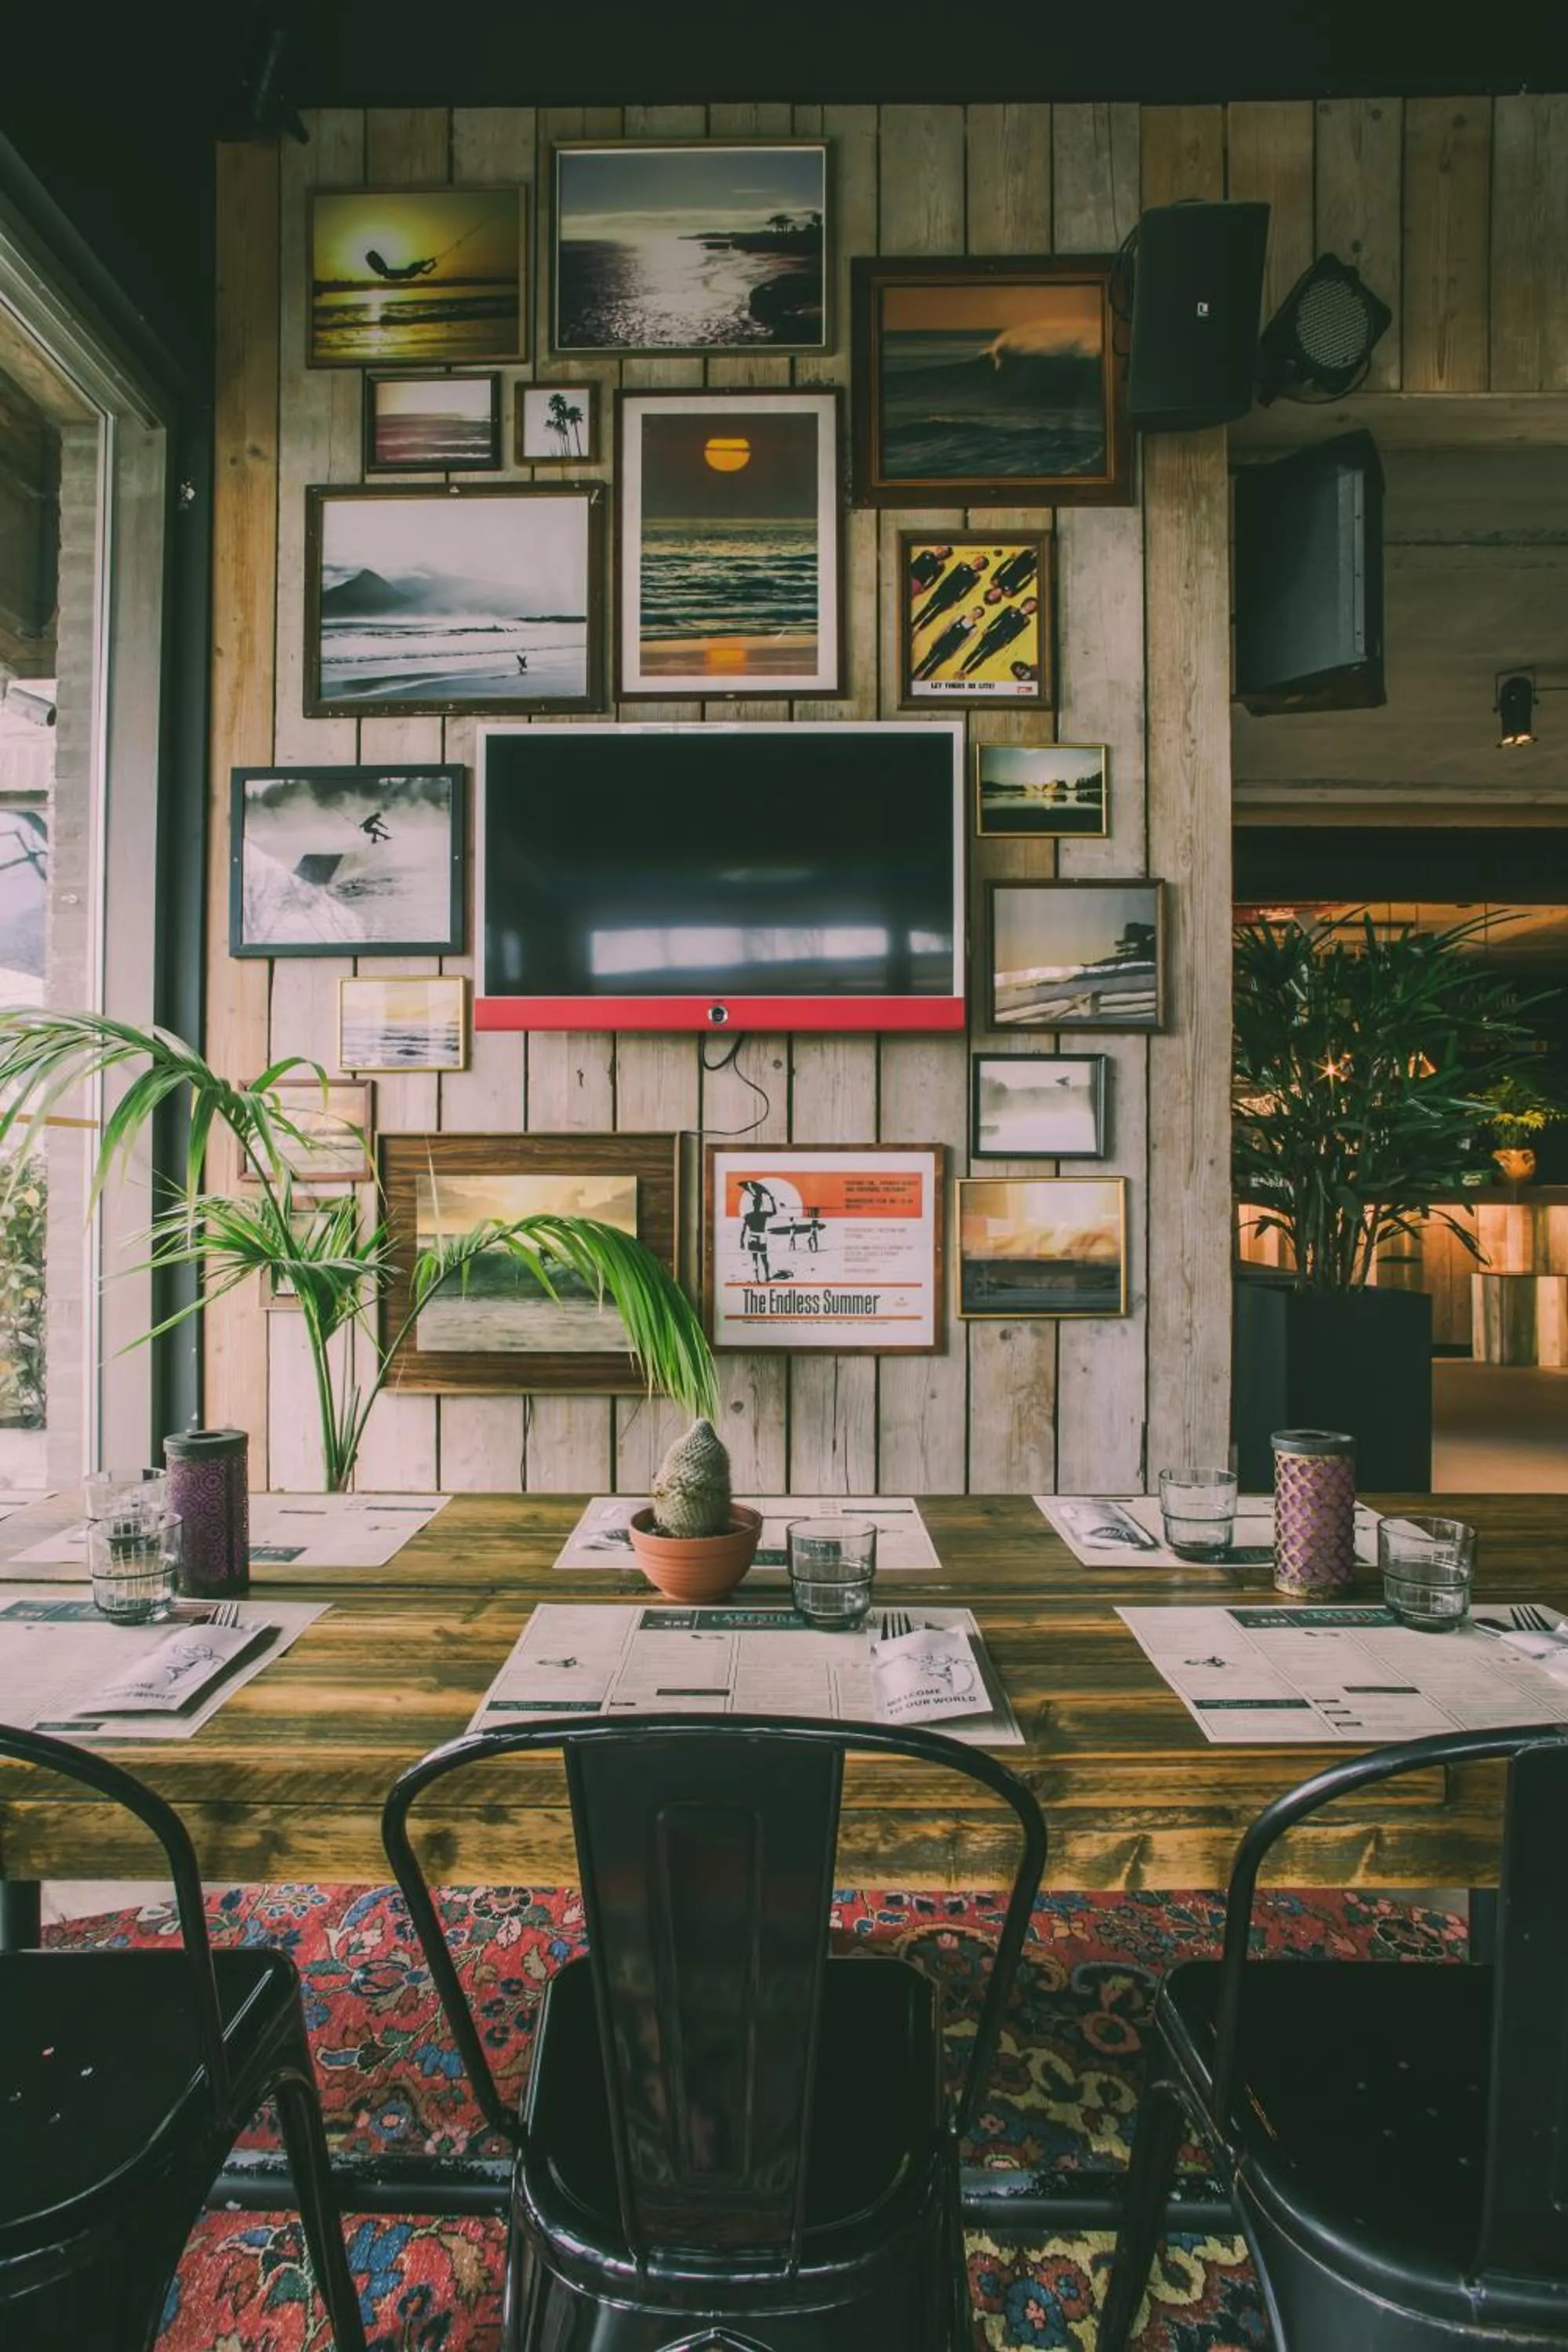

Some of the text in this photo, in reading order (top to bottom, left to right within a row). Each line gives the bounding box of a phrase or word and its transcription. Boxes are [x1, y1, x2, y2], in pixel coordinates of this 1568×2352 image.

[742, 1289, 880, 1315] The Endless Summer
[906, 1699, 931, 1708] OUR
[933, 1696, 977, 1704] WORLD
